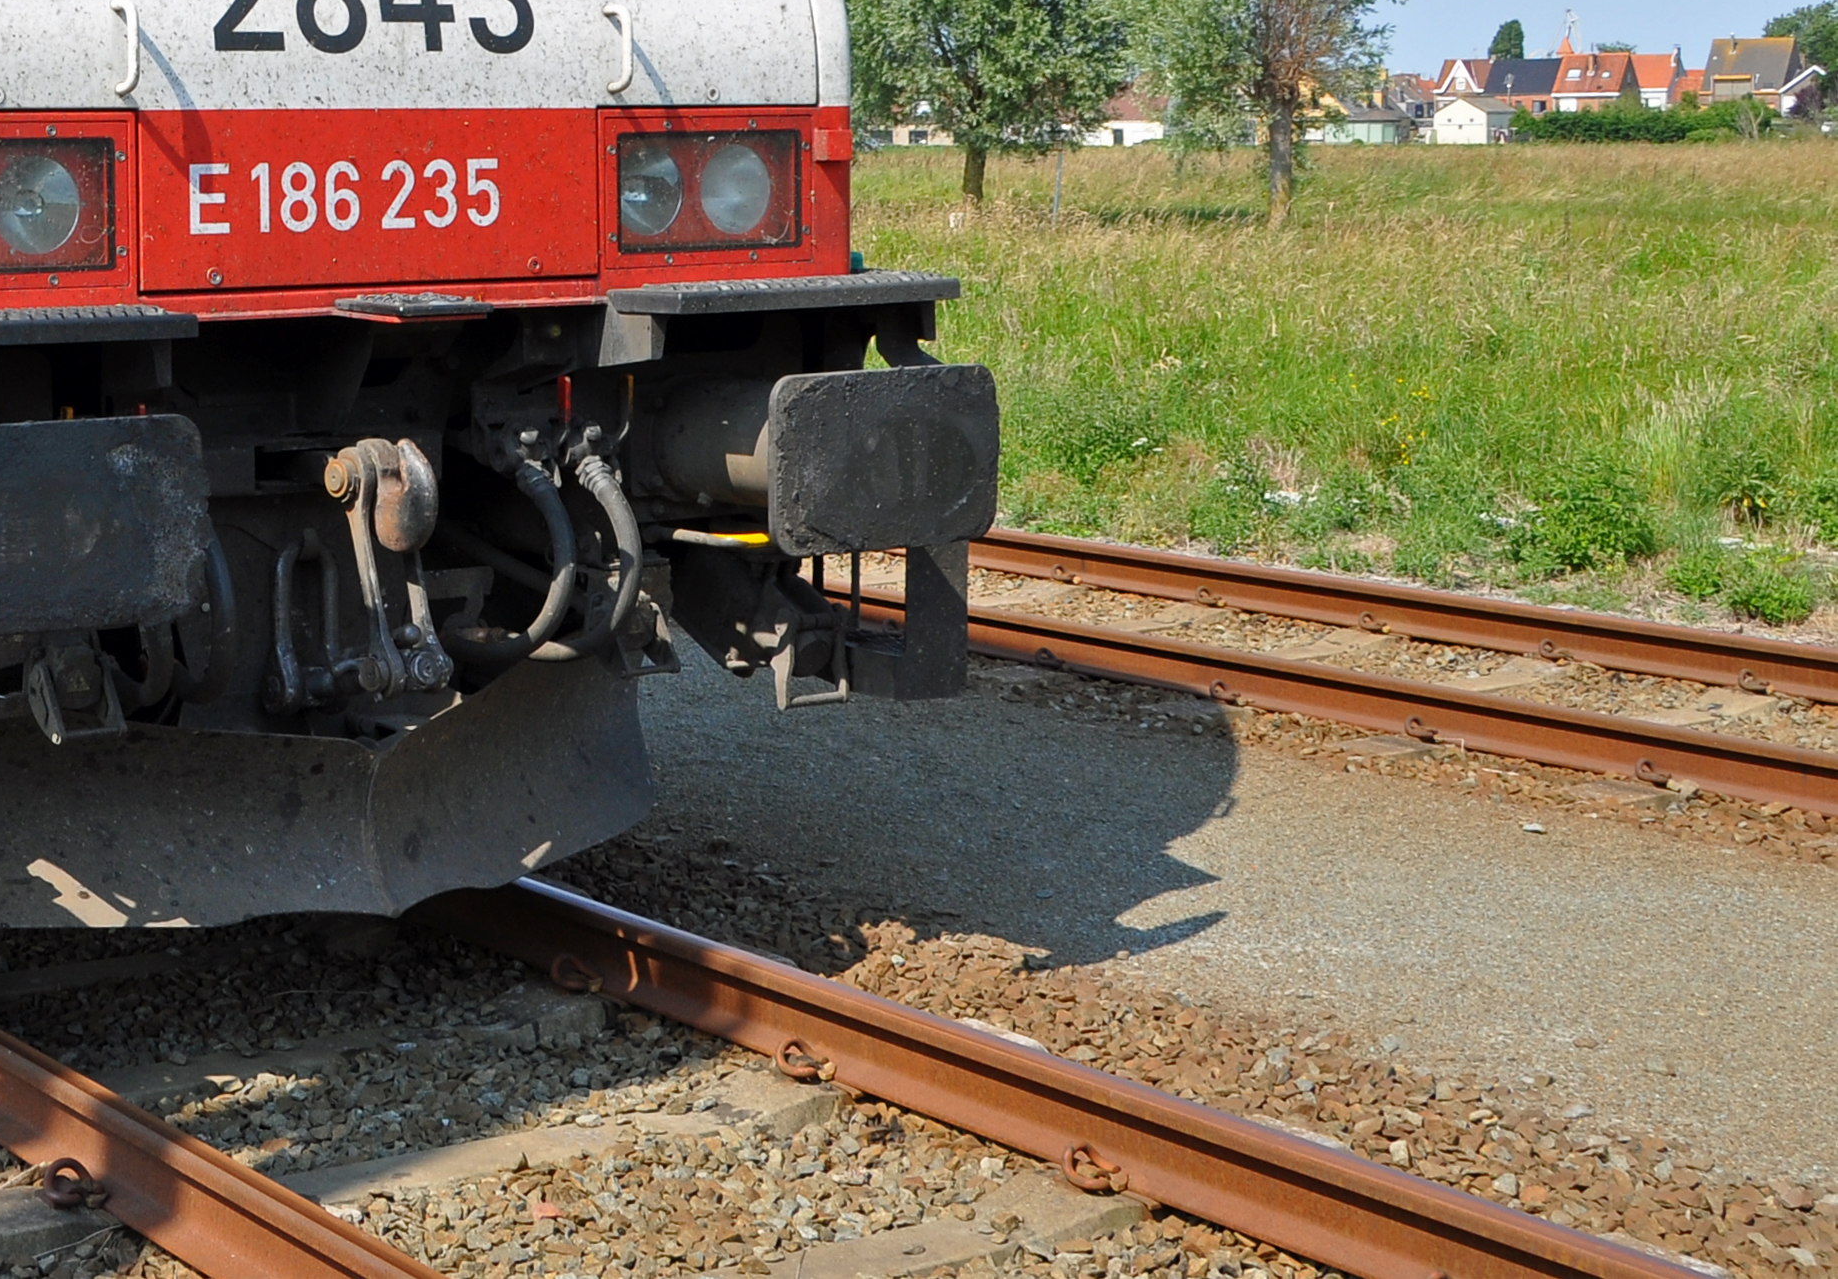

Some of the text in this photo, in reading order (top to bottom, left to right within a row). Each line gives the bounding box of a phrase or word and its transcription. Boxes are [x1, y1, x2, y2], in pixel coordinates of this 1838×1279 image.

[188, 157, 501, 236] E 186 235
